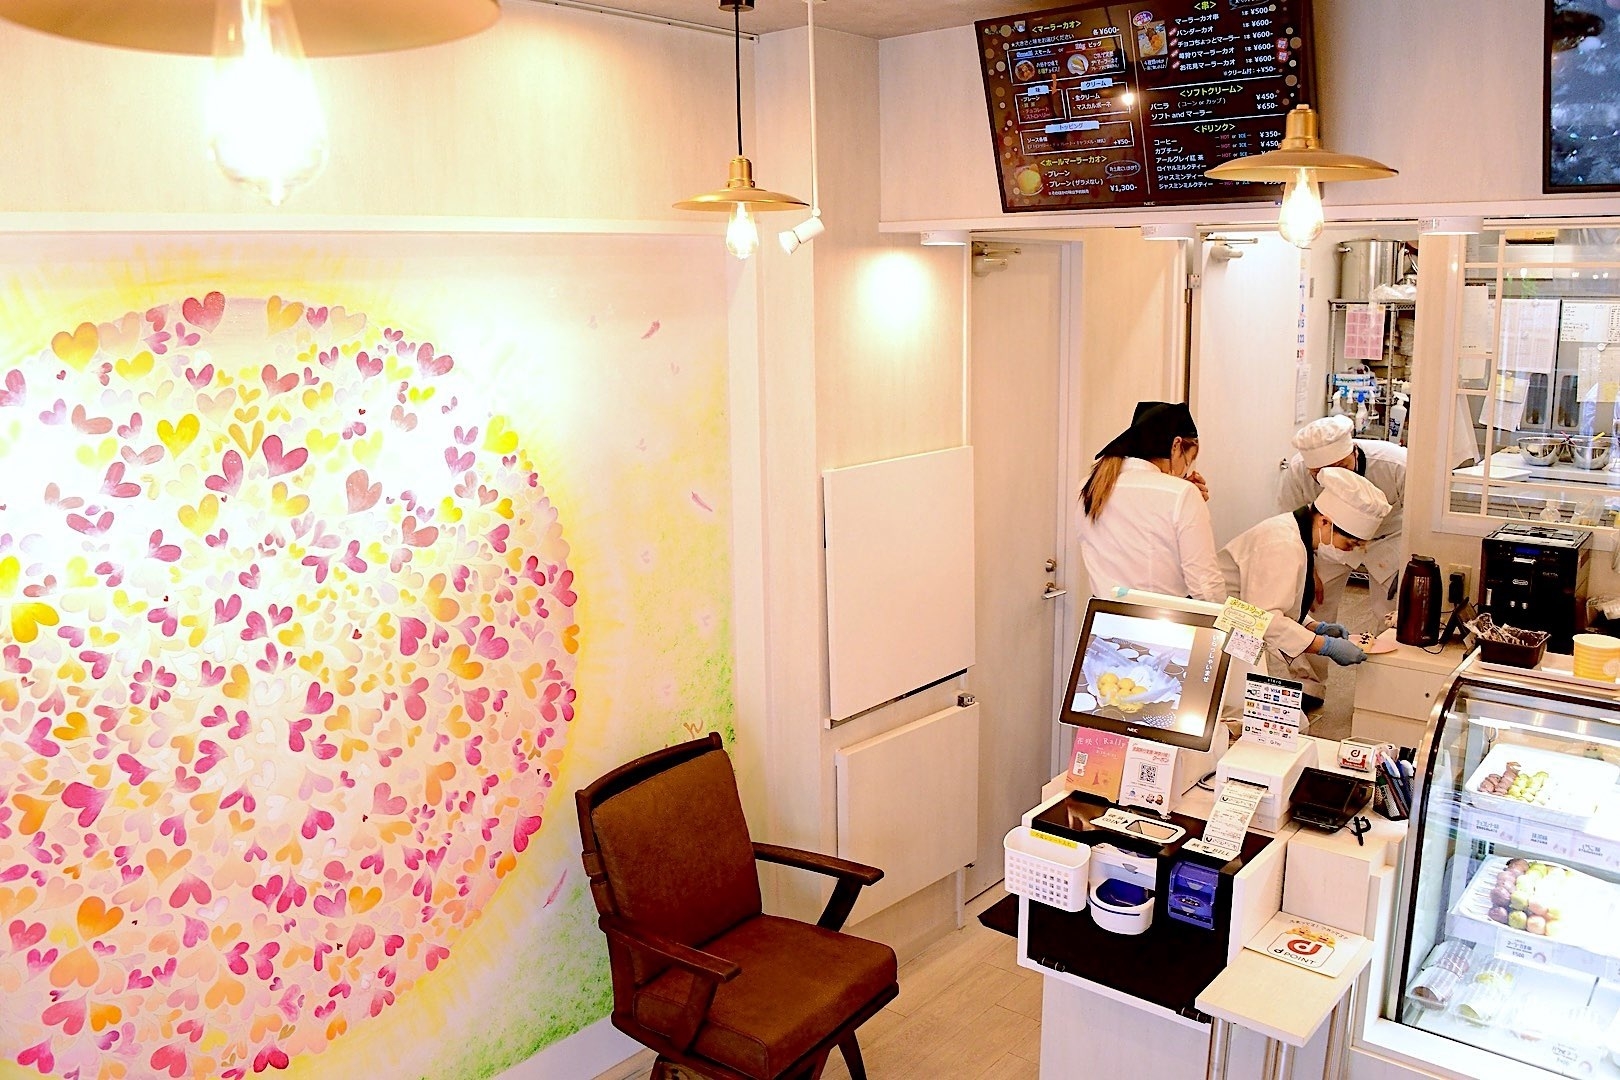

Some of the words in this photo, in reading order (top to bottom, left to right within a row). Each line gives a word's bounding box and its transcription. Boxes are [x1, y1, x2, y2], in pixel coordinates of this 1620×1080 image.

[1175, 13, 1219, 25] マーラーカオ串
[1251, 18, 1273, 27] ¥600-
[1252, 30, 1274, 39] ¥600-
[1177, 35, 1241, 48] チョコちょっとマーラー
[1253, 42, 1275, 51] ¥600-
[1254, 54, 1276, 63] ¥600-
[1180, 58, 1236, 72] お花見マーラーカオ
[1256, 92, 1278, 100] ¥450-
[1256, 102, 1279, 110] ¥650-
[1151, 112, 1171, 121] ソフト
[1172, 110, 1184, 119] and
[1186, 109, 1213, 118] マーラー
[1059, 122, 1084, 130] トッピング
[1154, 138, 1178, 146] コーヒー
[1154, 147, 1184, 155] カプチーノ
[1156, 163, 1207, 172] ロイヤルミルクティー
[1110, 184, 1138, 192] ¥1,300-
[1104, 738, 1126, 748] Rally
[1102, 817, 1120, 825] COIN
[1284, 952, 1316, 965] POINT
